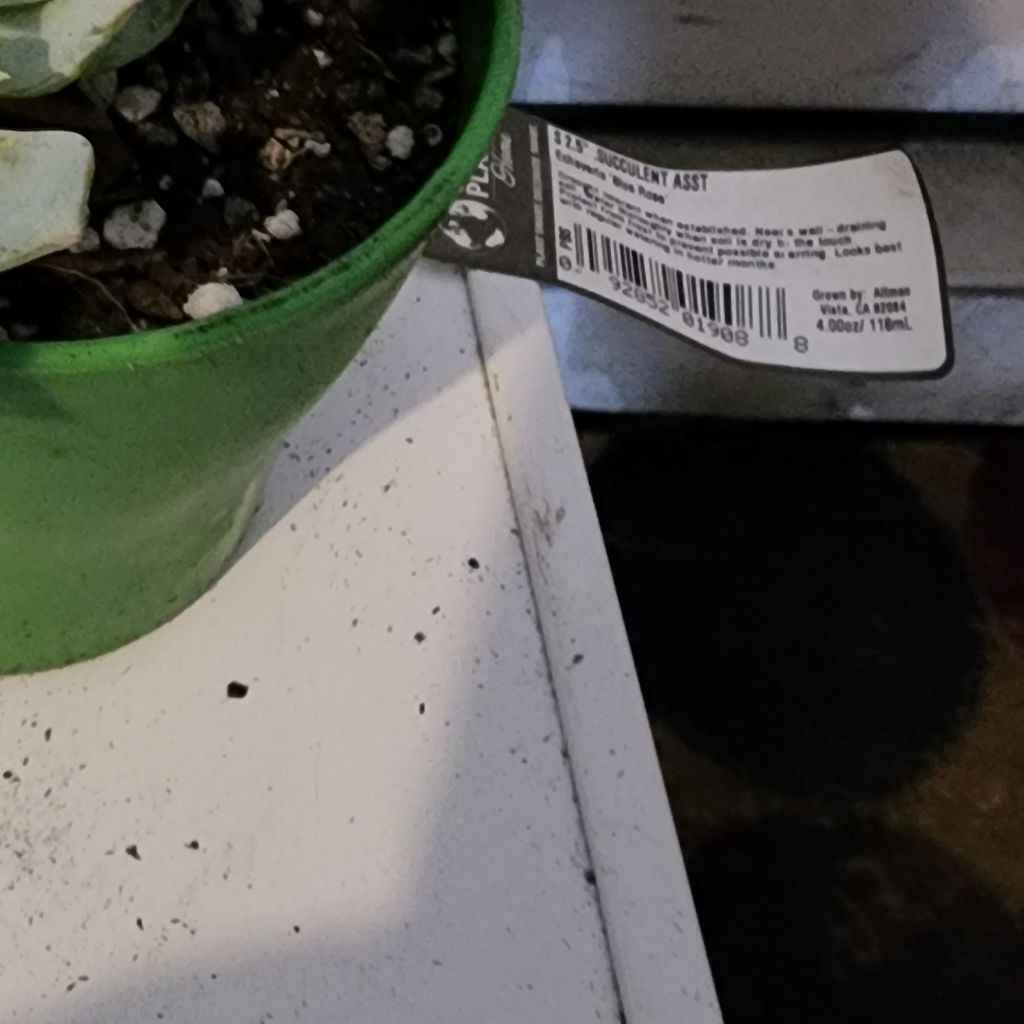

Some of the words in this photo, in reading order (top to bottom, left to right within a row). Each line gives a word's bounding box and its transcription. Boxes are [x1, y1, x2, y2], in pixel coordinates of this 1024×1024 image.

[595, 148, 668, 187] SUCCULENT
[673, 173, 708, 192] ASST
[812, 288, 847, 301] Grown
[793, 335, 809, 354] 8
